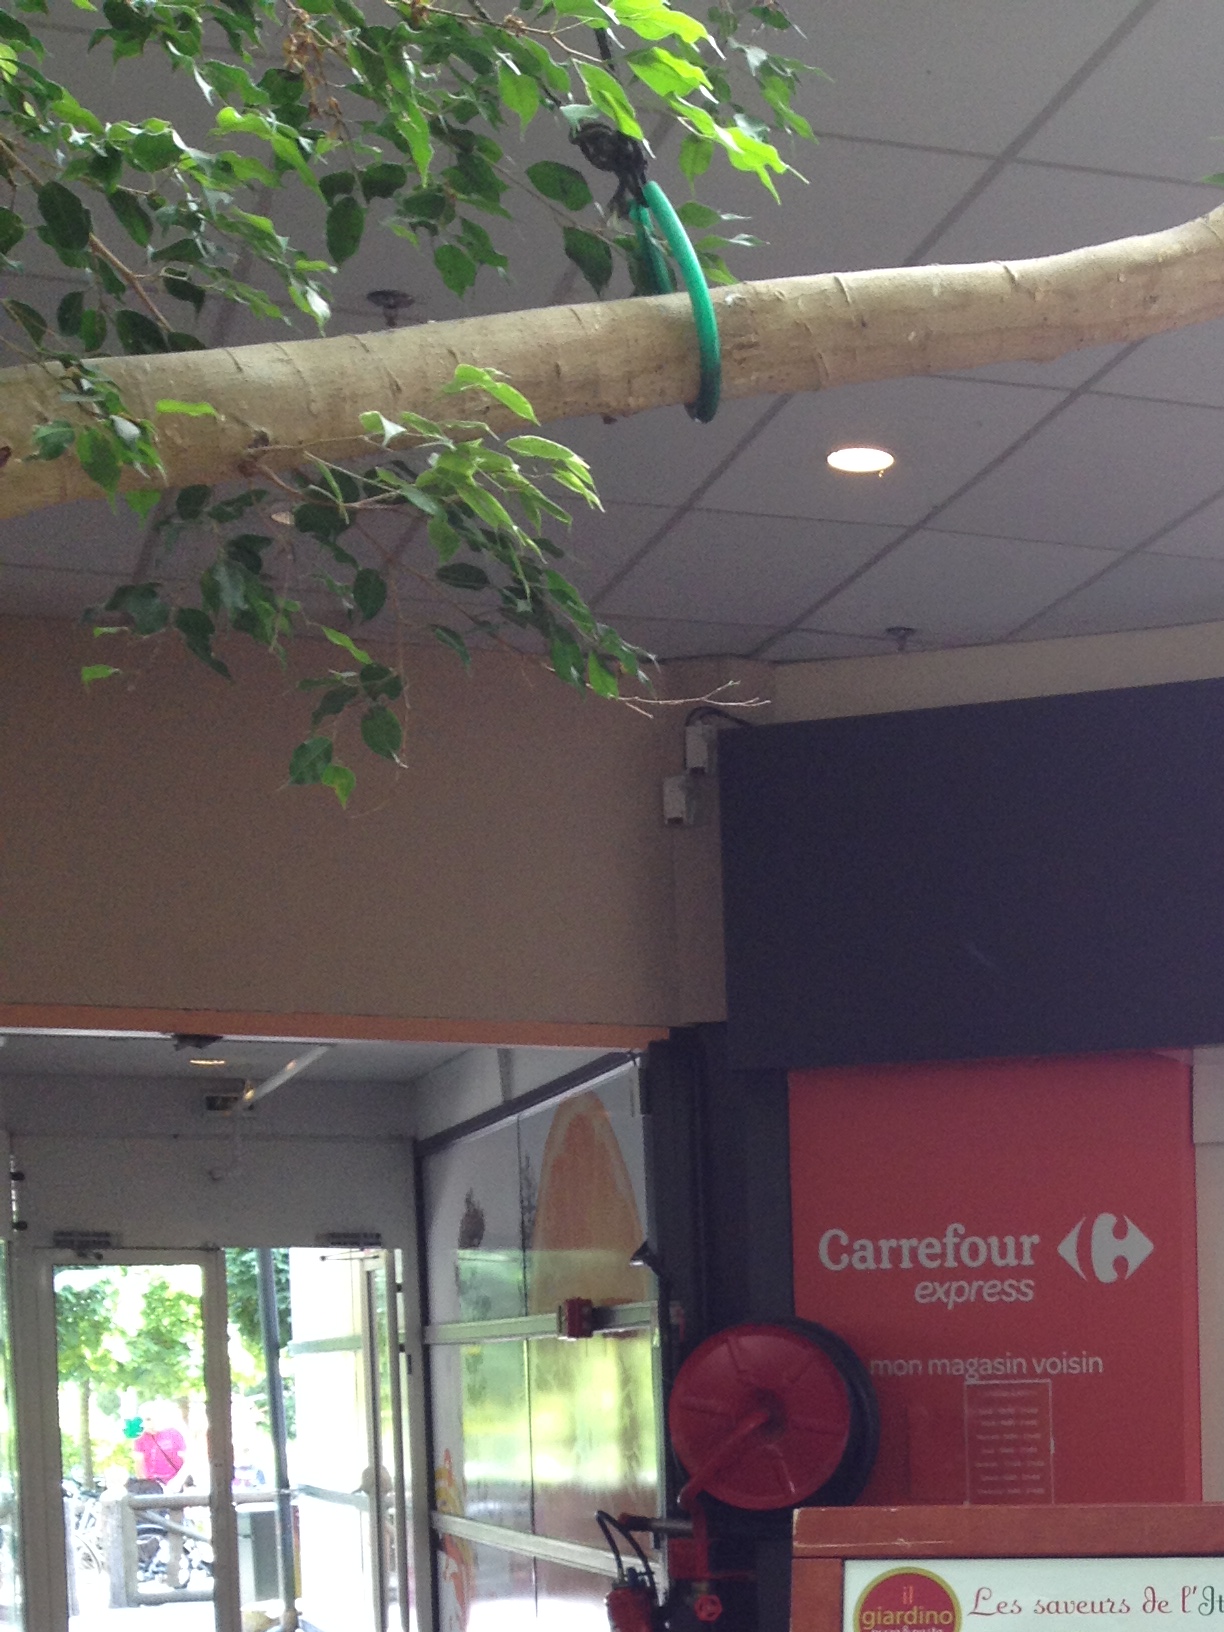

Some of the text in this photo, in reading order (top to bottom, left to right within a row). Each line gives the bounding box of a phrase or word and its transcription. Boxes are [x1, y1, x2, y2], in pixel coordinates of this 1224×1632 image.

[818, 1223, 1040, 1271] Carrefour
[914, 1278, 1035, 1310] express
[870, 1351, 1104, 1381] mon magasin voisin
[902, 1585, 914, 1605] il
[967, 1586, 1023, 1616] Les
[1032, 1596, 1132, 1615] saveurs
[1141, 1585, 1173, 1615] de
[861, 1605, 954, 1631] giardino
